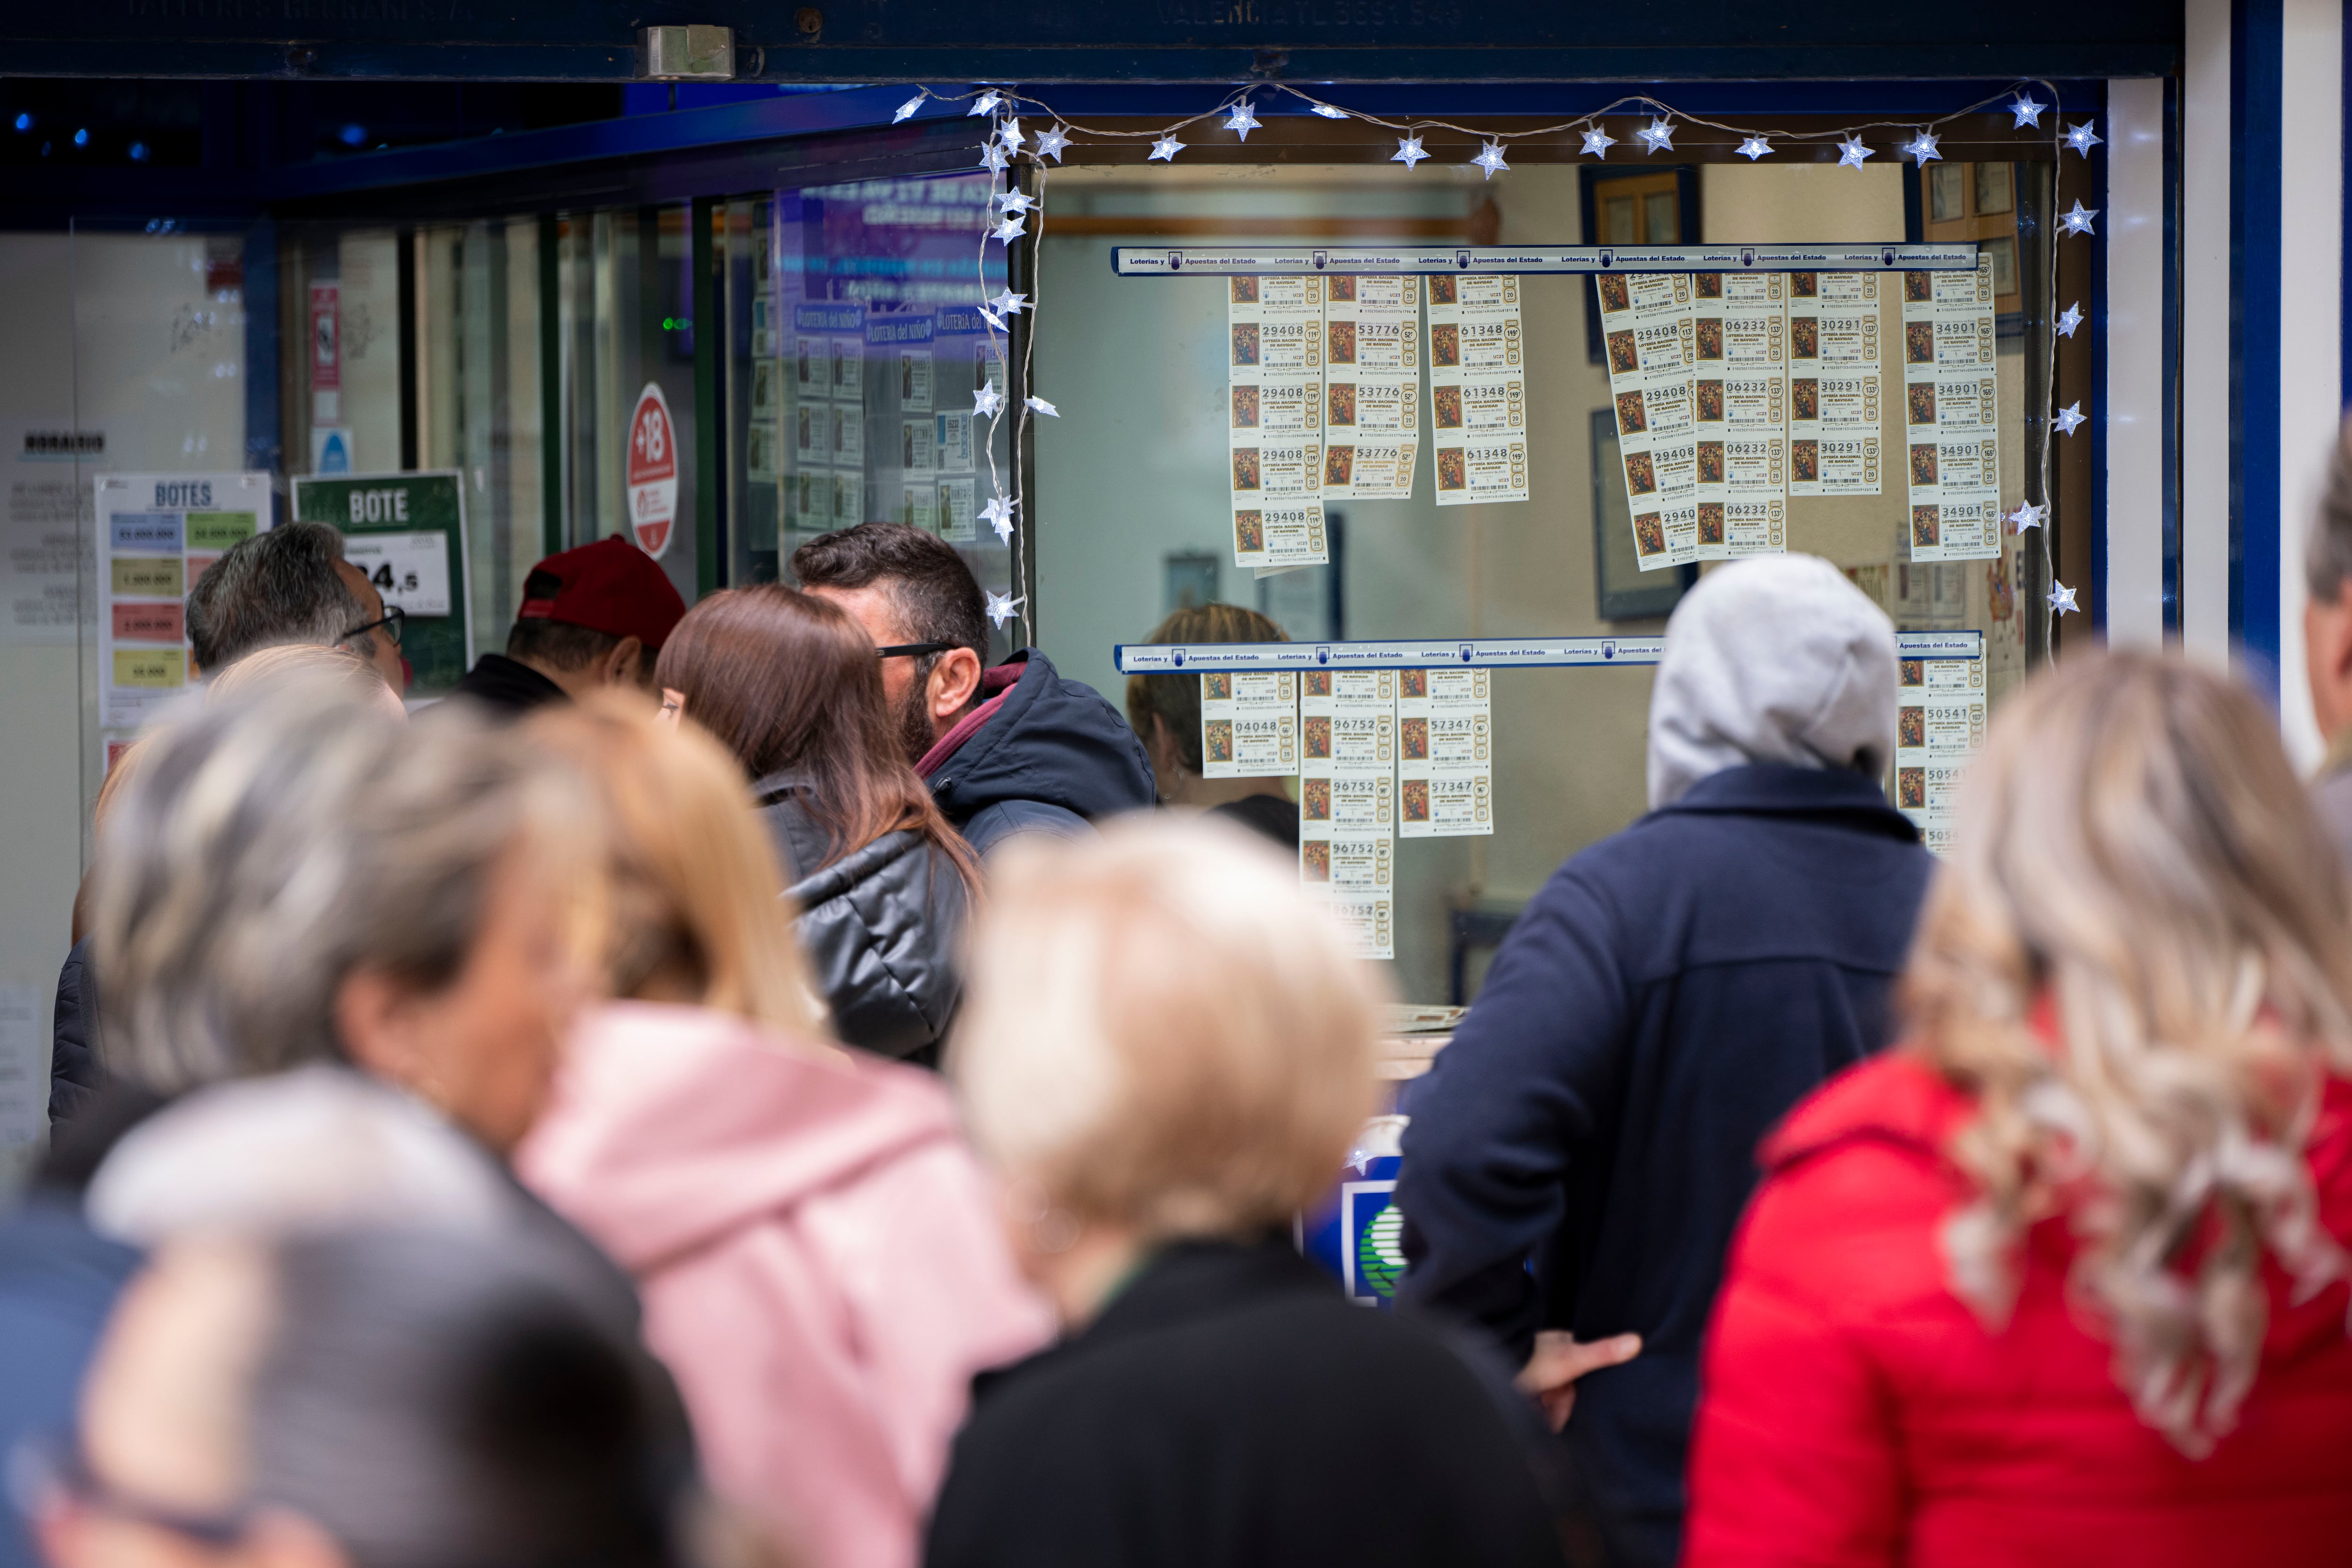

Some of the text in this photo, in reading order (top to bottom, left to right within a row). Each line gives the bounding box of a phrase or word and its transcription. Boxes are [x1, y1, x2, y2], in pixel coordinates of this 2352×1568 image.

[972, 313, 981, 329] del
[1726, 321, 1765, 330] 06232
[1821, 320, 1859, 329] 30291
[898, 325, 907, 340] del
[909, 320, 925, 339] NIÑO
[1263, 326, 1303, 335] 29408
[1359, 326, 1399, 334] 53776
[1462, 325, 1502, 334] 61348
[1638, 326, 1677, 340] 29408
[1937, 324, 1975, 333] 34901
[1726, 383, 1766, 391] 06232
[1822, 382, 1860, 390] 30291
[1939, 384, 1977, 394] 34901
[1263, 389, 1302, 398] 29408
[1359, 388, 1399, 396] 53776
[1464, 387, 1504, 397] 61348
[1646, 387, 1686, 401] 29408
[636, 409, 665, 463] +18
[1727, 444, 1766, 453] 06232
[1822, 443, 1860, 452] 30291
[1941, 446, 1979, 455] 34901
[1263, 451, 1302, 460] 29408
[1467, 449, 1507, 459] 61348
[1655, 447, 1694, 461] 29408
[155, 482, 212, 507] BOTES
[349, 489, 410, 523] BOTE
[1727, 506, 1766, 514] 06232
[1942, 507, 1980, 516] 34901
[1265, 512, 1304, 521] 29408
[1928, 709, 1966, 718] 50541
[1236, 722, 1276, 731] 04048
[1335, 720, 1374, 729] 96752
[1431, 720, 1470, 729] 57347
[1432, 782, 1471, 791] 57347
